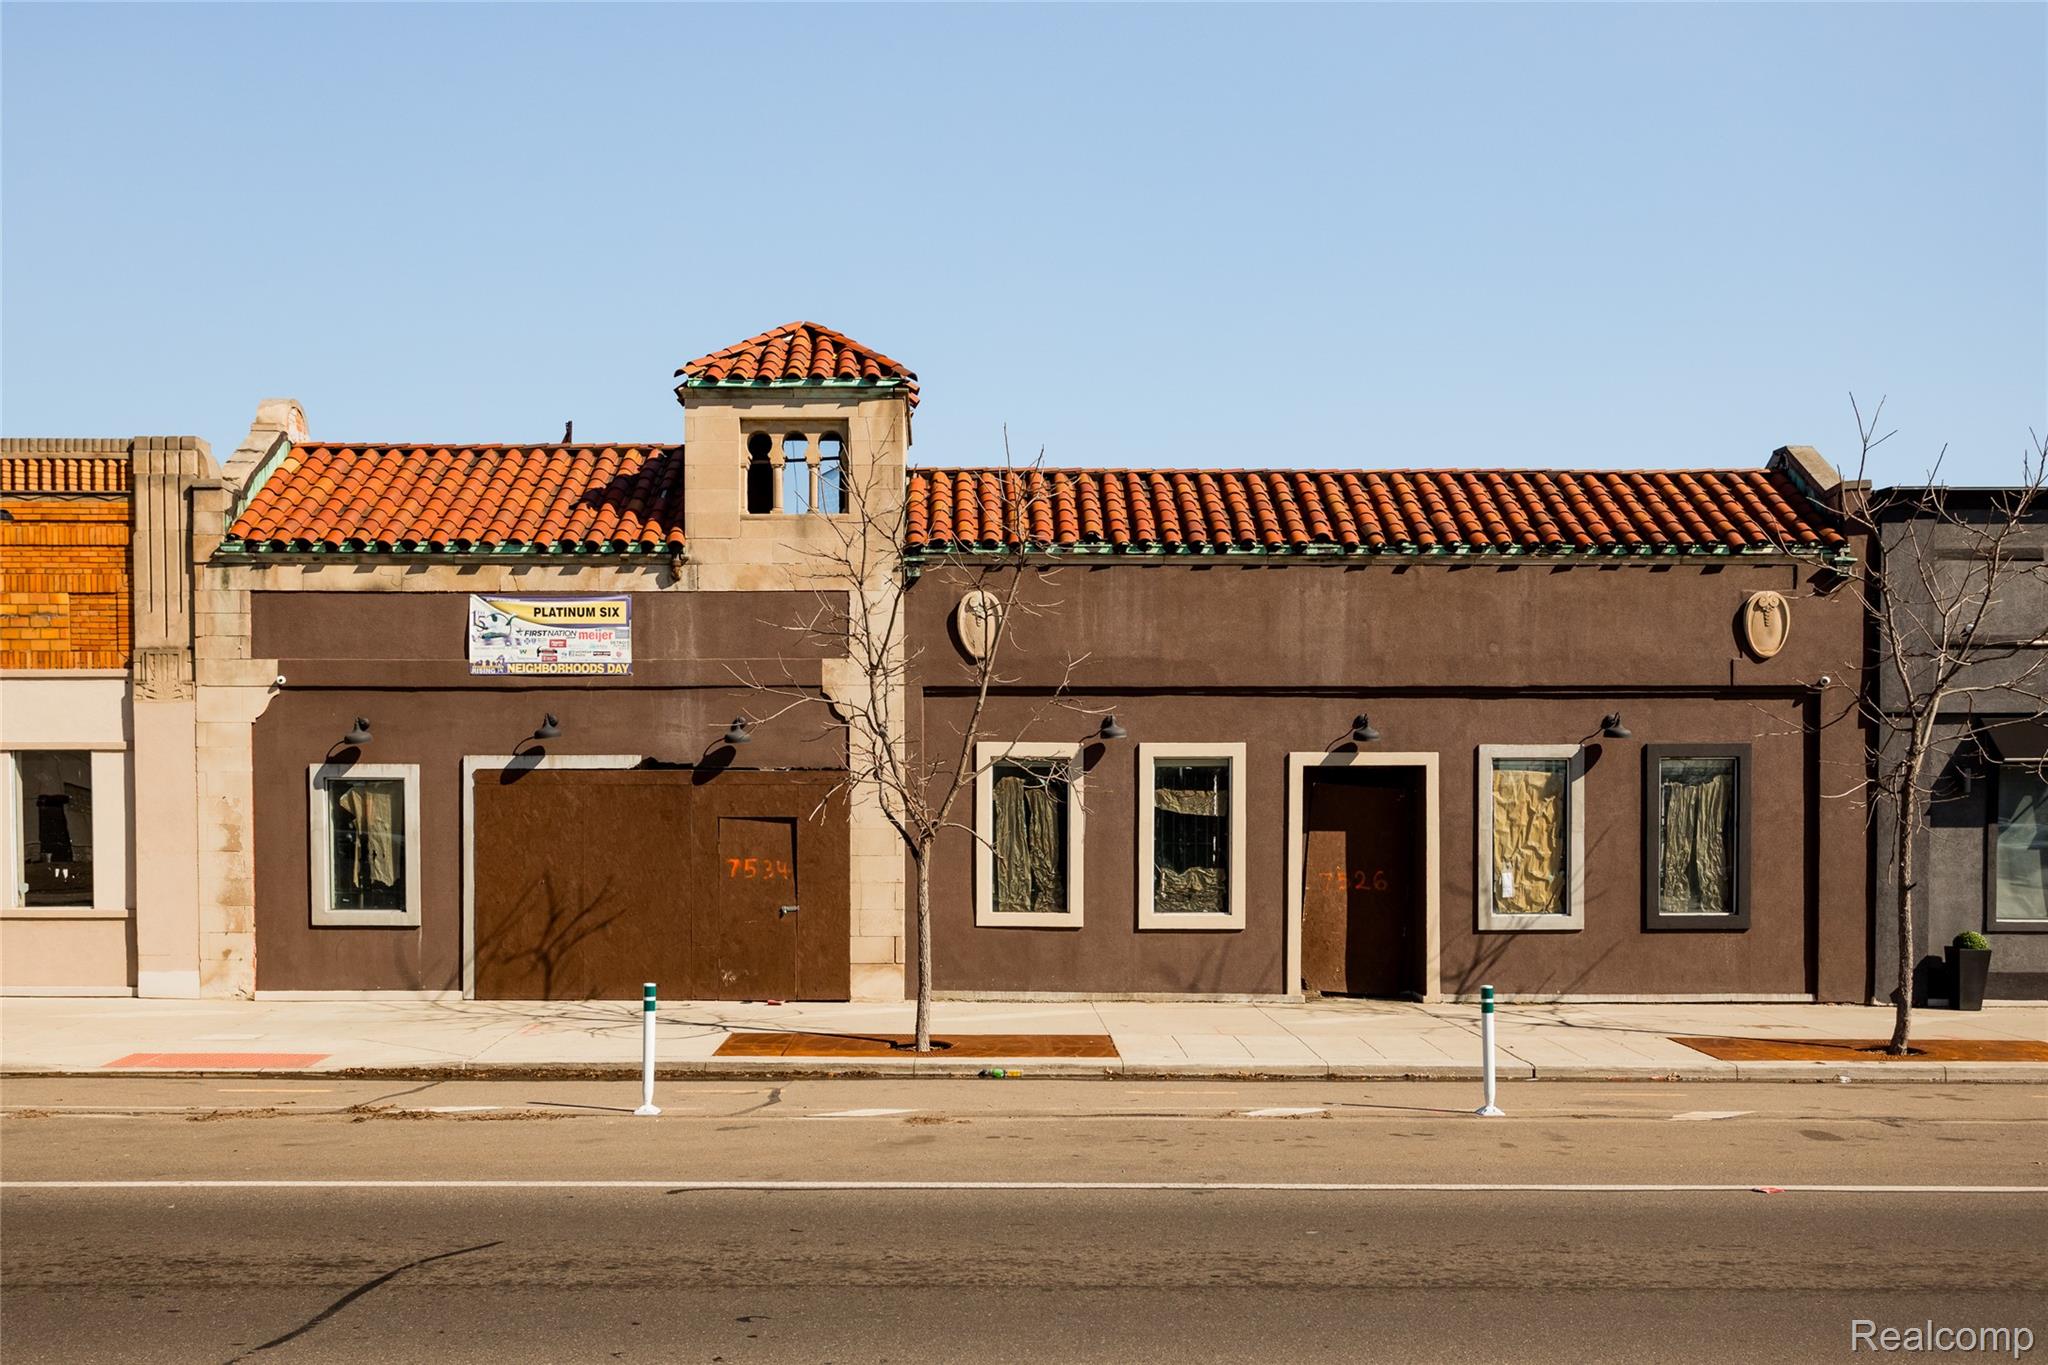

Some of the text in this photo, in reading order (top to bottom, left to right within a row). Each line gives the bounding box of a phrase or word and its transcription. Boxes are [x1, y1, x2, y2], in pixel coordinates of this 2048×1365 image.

[534, 607, 619, 618] PLATINUM SIX
[578, 628, 613, 642] meijer
[507, 663, 604, 674] NEIGHBORHOODS
[607, 663, 629, 673] DAY
